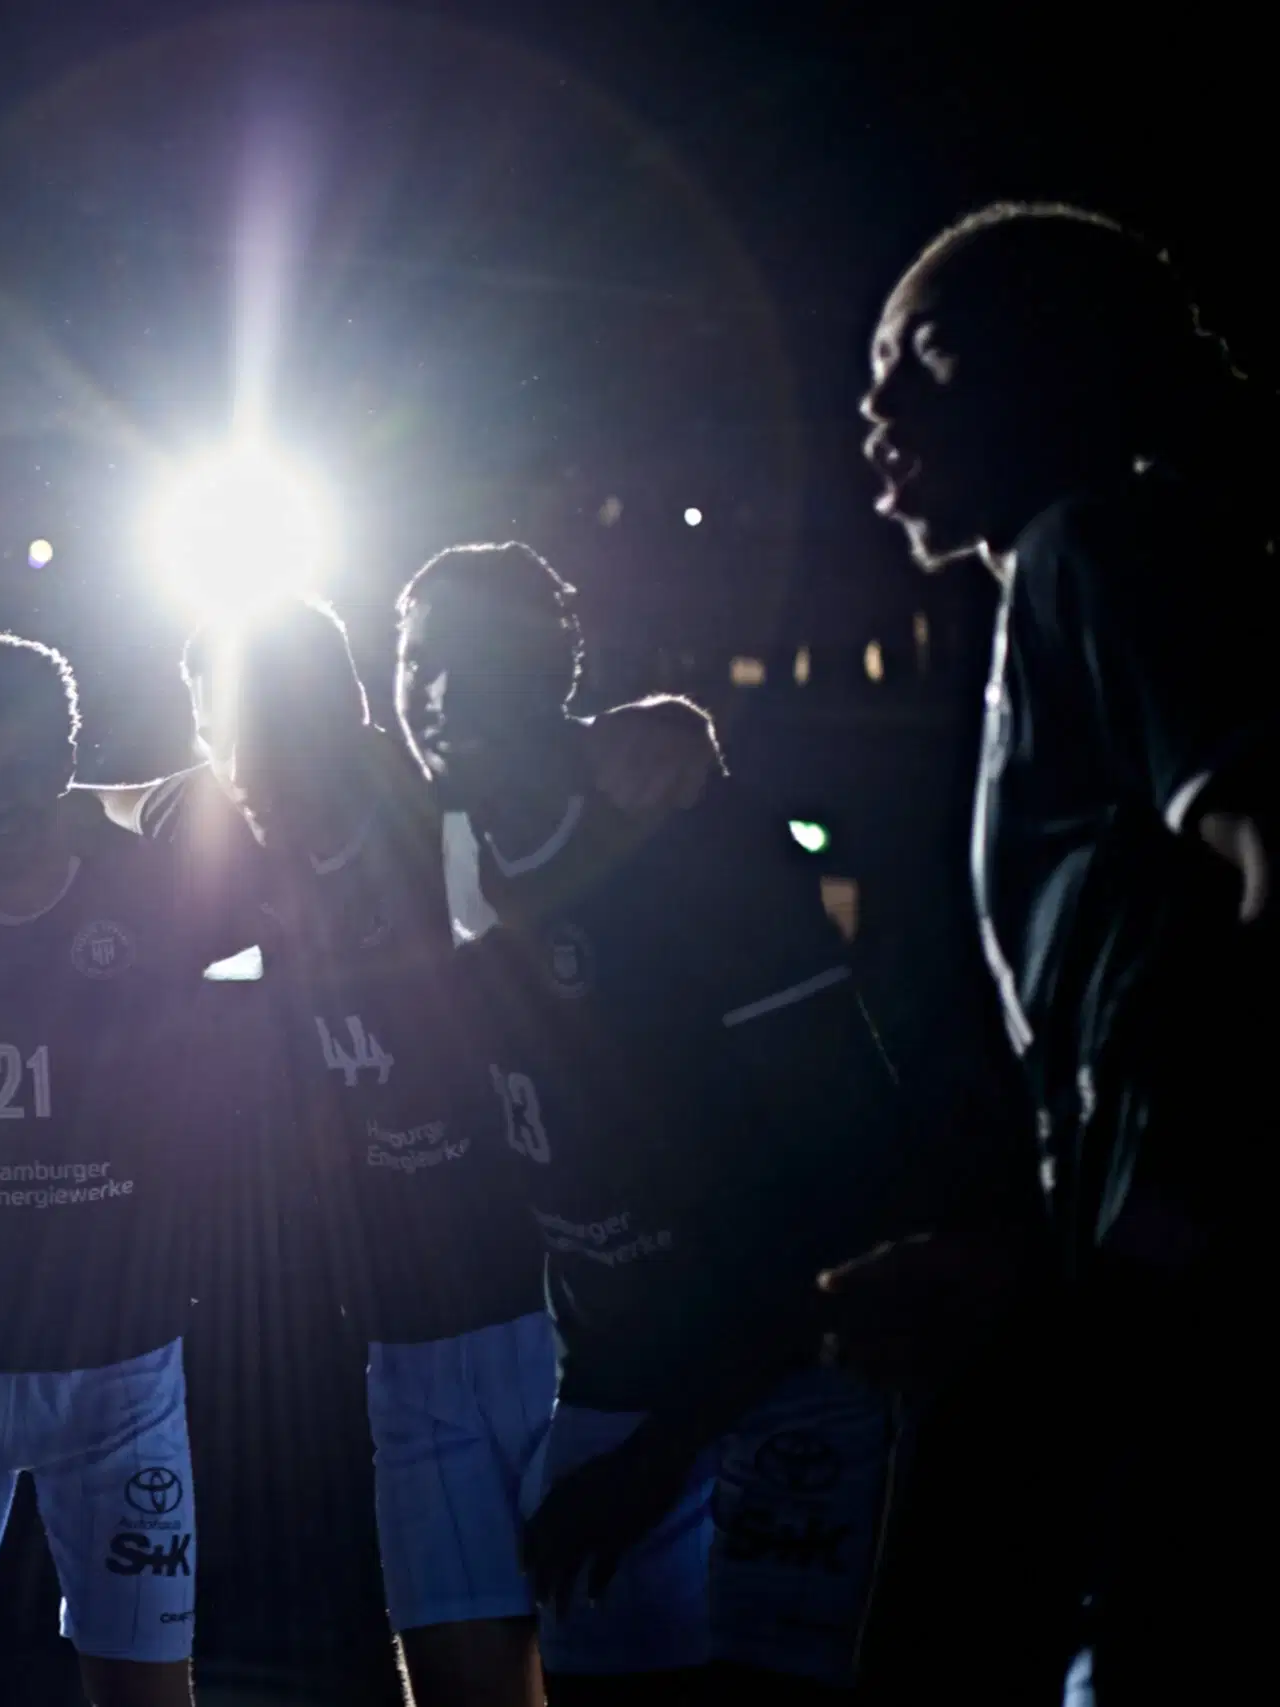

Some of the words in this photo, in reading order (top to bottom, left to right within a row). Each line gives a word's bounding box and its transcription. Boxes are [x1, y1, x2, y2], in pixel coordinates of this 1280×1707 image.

[314, 1015, 395, 1087] 44
[366, 1119, 446, 1148] Hburg
[106, 1532, 190, 1577] S+K
